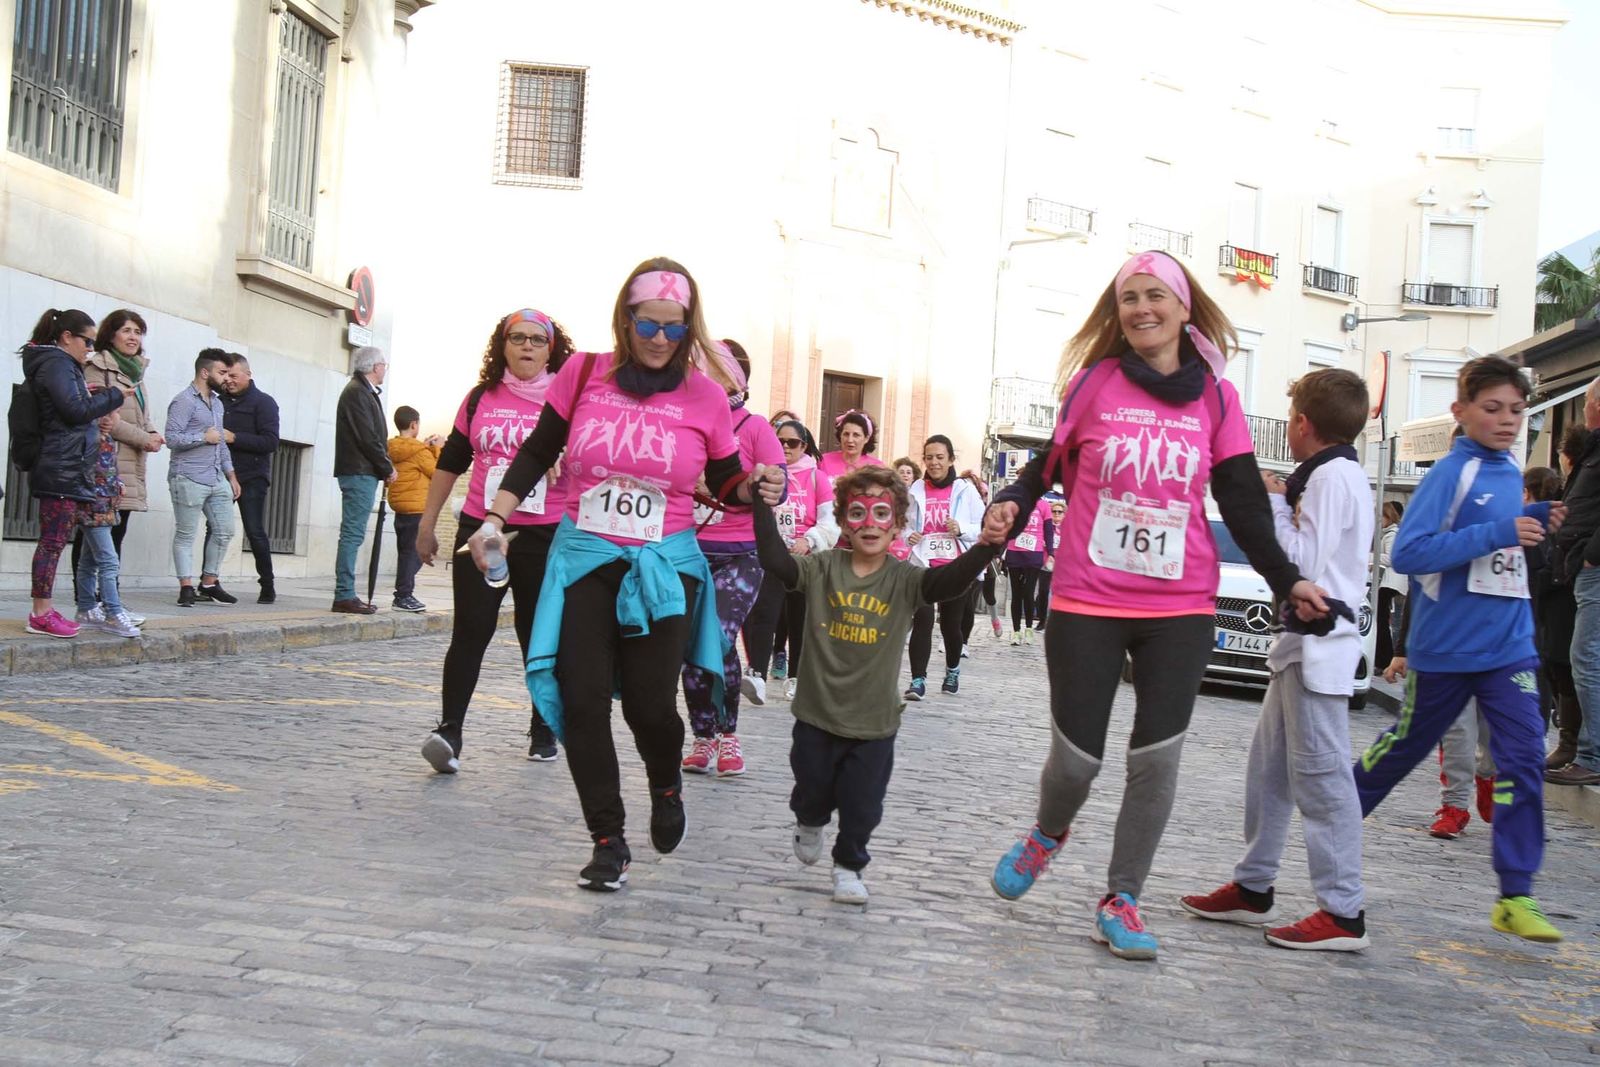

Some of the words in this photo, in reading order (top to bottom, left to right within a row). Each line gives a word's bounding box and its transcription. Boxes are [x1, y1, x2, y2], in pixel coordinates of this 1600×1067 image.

[589, 393, 600, 403] DE
[600, 397, 609, 405] LA
[610, 400, 637, 411] MUJER
[645, 405, 683, 420] RUNNING
[1117, 407, 1157, 418] CARRERA
[1100, 412, 1112, 421] DE
[1113, 413, 1124, 422] LA
[1126, 415, 1156, 426] MUJER
[600, 489, 652, 518] 160
[929, 540, 952, 551] 543
[1116, 525, 1167, 556] 161
[843, 611, 865, 625] PARA
[829, 620, 878, 645] LUCHAR
[1227, 635, 1260, 650] 7144
